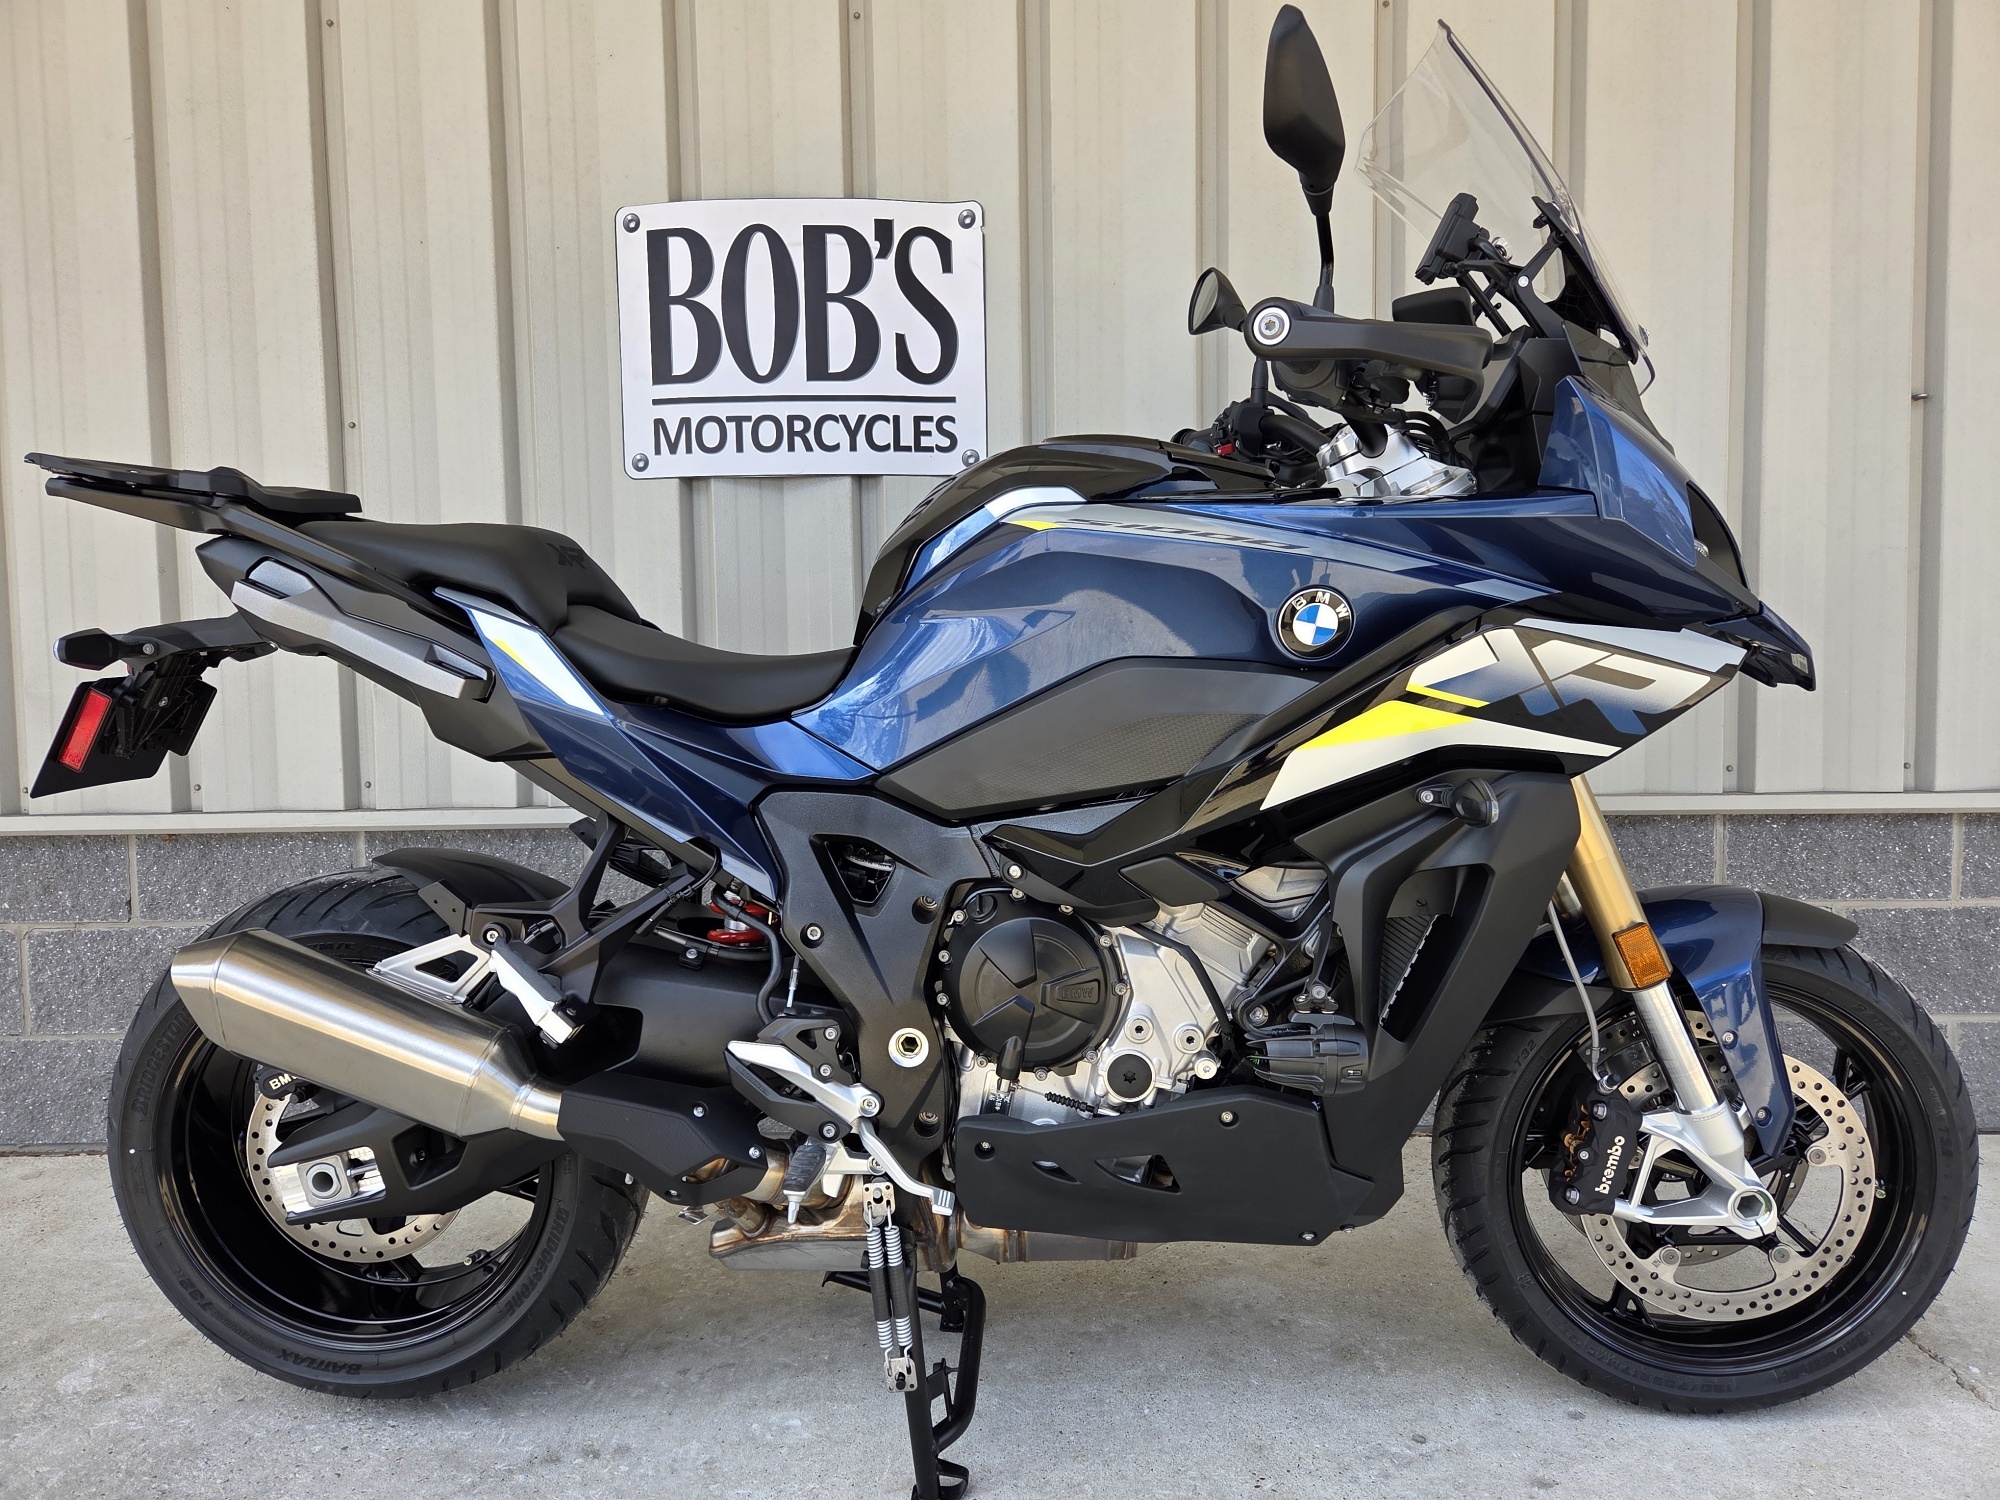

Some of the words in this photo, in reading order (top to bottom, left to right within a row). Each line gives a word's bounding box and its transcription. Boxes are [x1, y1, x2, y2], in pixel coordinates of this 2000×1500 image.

[646, 218, 959, 386] BOB'S
[653, 414, 958, 456] MOTORCYCLES
[1291, 590, 1350, 619] BMW
[1407, 628, 1711, 736] XR
[1061, 987, 1095, 999] BMW
[268, 1073, 302, 1090] BM
[1594, 1135, 1626, 1195] brembo
[500, 1207, 571, 1317] BRIDGESTONE
[275, 1347, 362, 1374] BATTLAX
